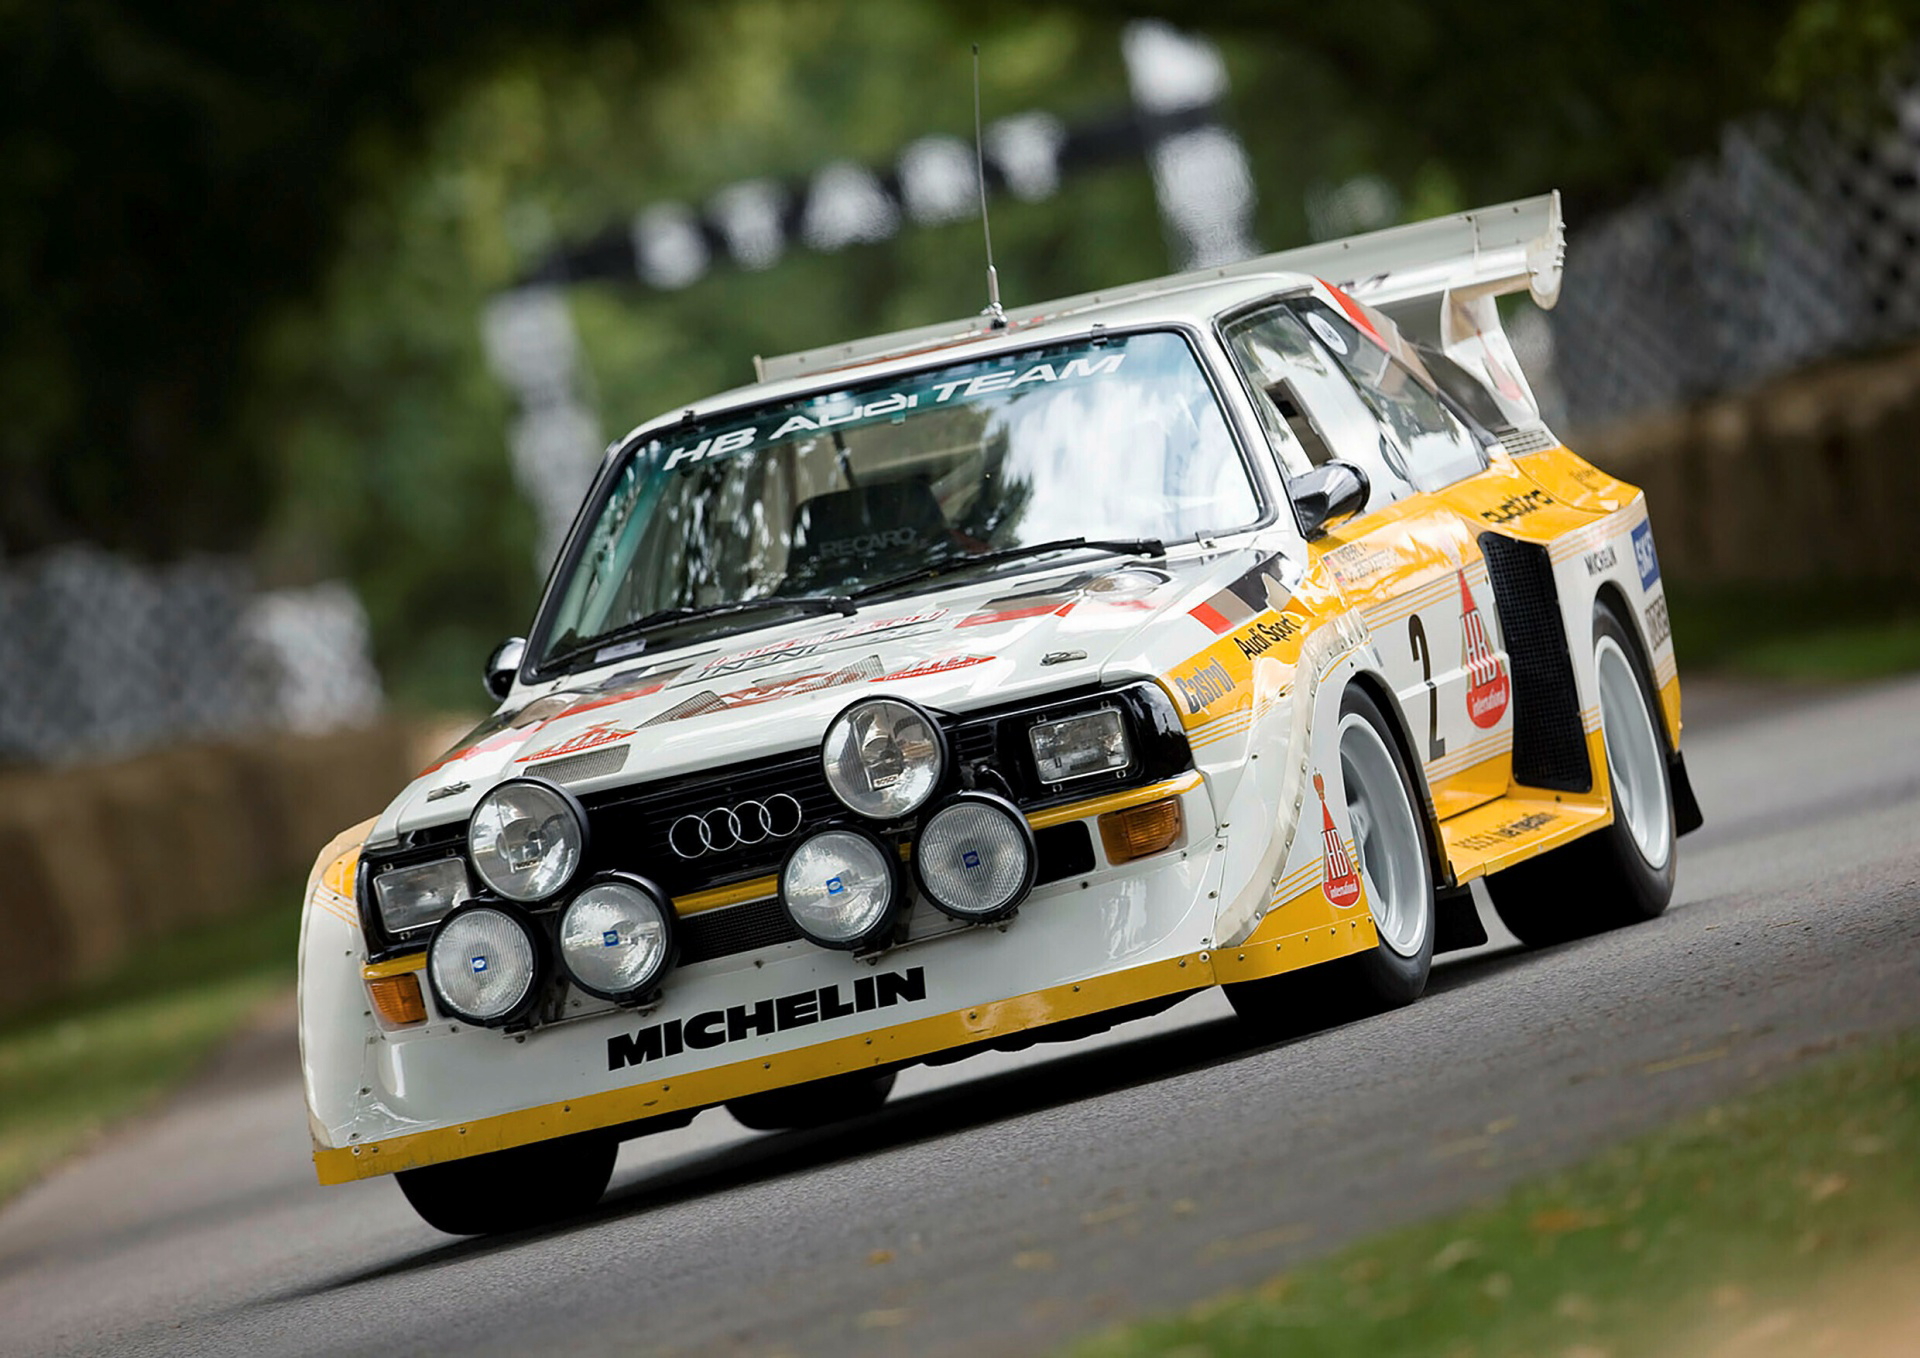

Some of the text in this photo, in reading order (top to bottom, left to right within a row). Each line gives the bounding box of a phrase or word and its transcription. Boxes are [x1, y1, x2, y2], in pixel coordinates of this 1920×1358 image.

[662, 426, 758, 471] HB
[932, 354, 1126, 403] TEAM
[1233, 614, 1302, 660] Audi Sport
[1174, 656, 1236, 714] Castrol
[1408, 614, 1446, 763] 2
[1321, 828, 1349, 880] HB
[607, 966, 927, 1072] MICHELIN
